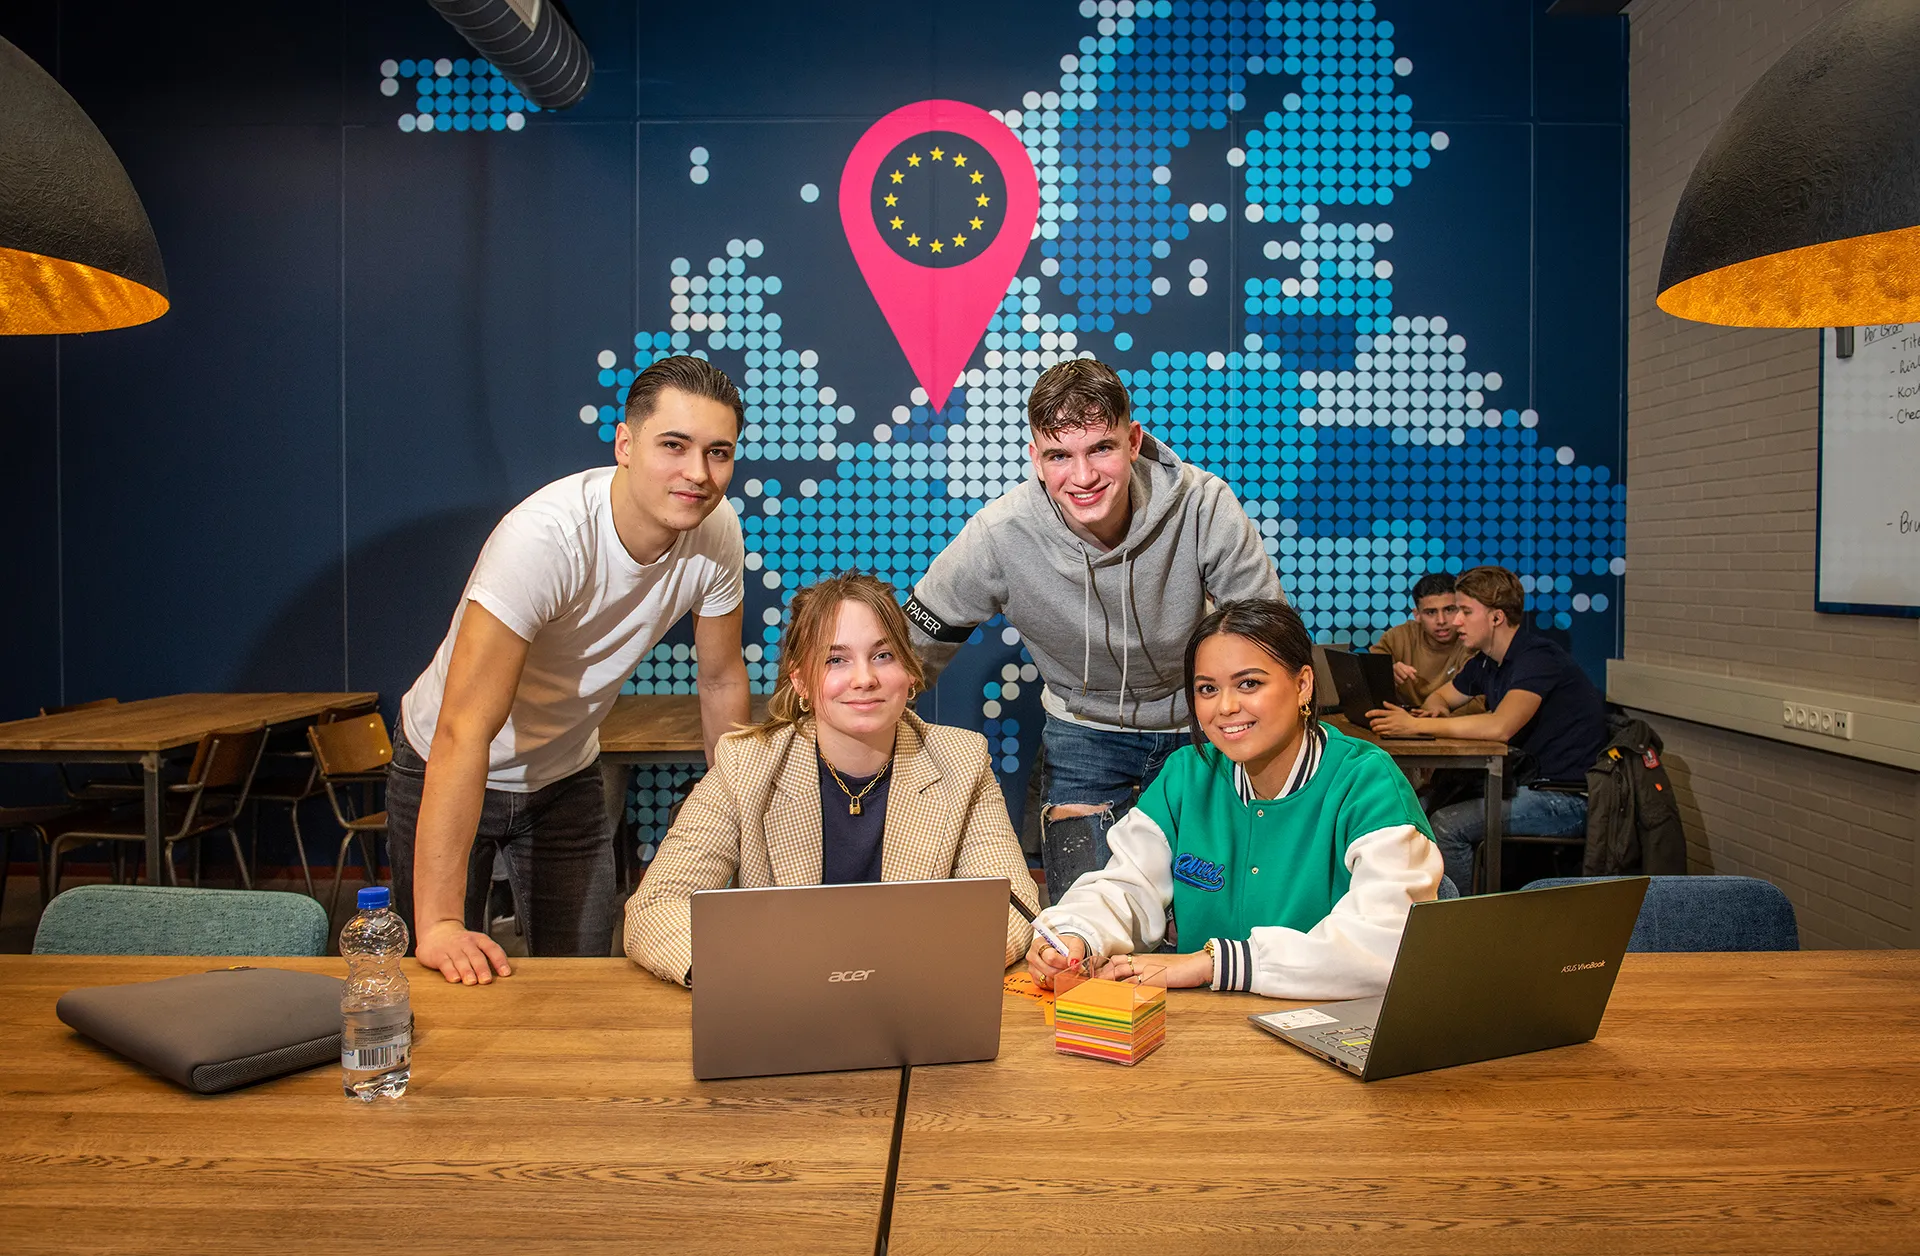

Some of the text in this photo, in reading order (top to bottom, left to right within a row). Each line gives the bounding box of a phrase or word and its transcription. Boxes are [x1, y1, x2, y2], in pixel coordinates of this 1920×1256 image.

[906, 601, 942, 635] PAPER
[1174, 853, 1225, 886] Wild
[828, 969, 876, 982] acer
[1560, 960, 1606, 973] ASUS VivoBook
